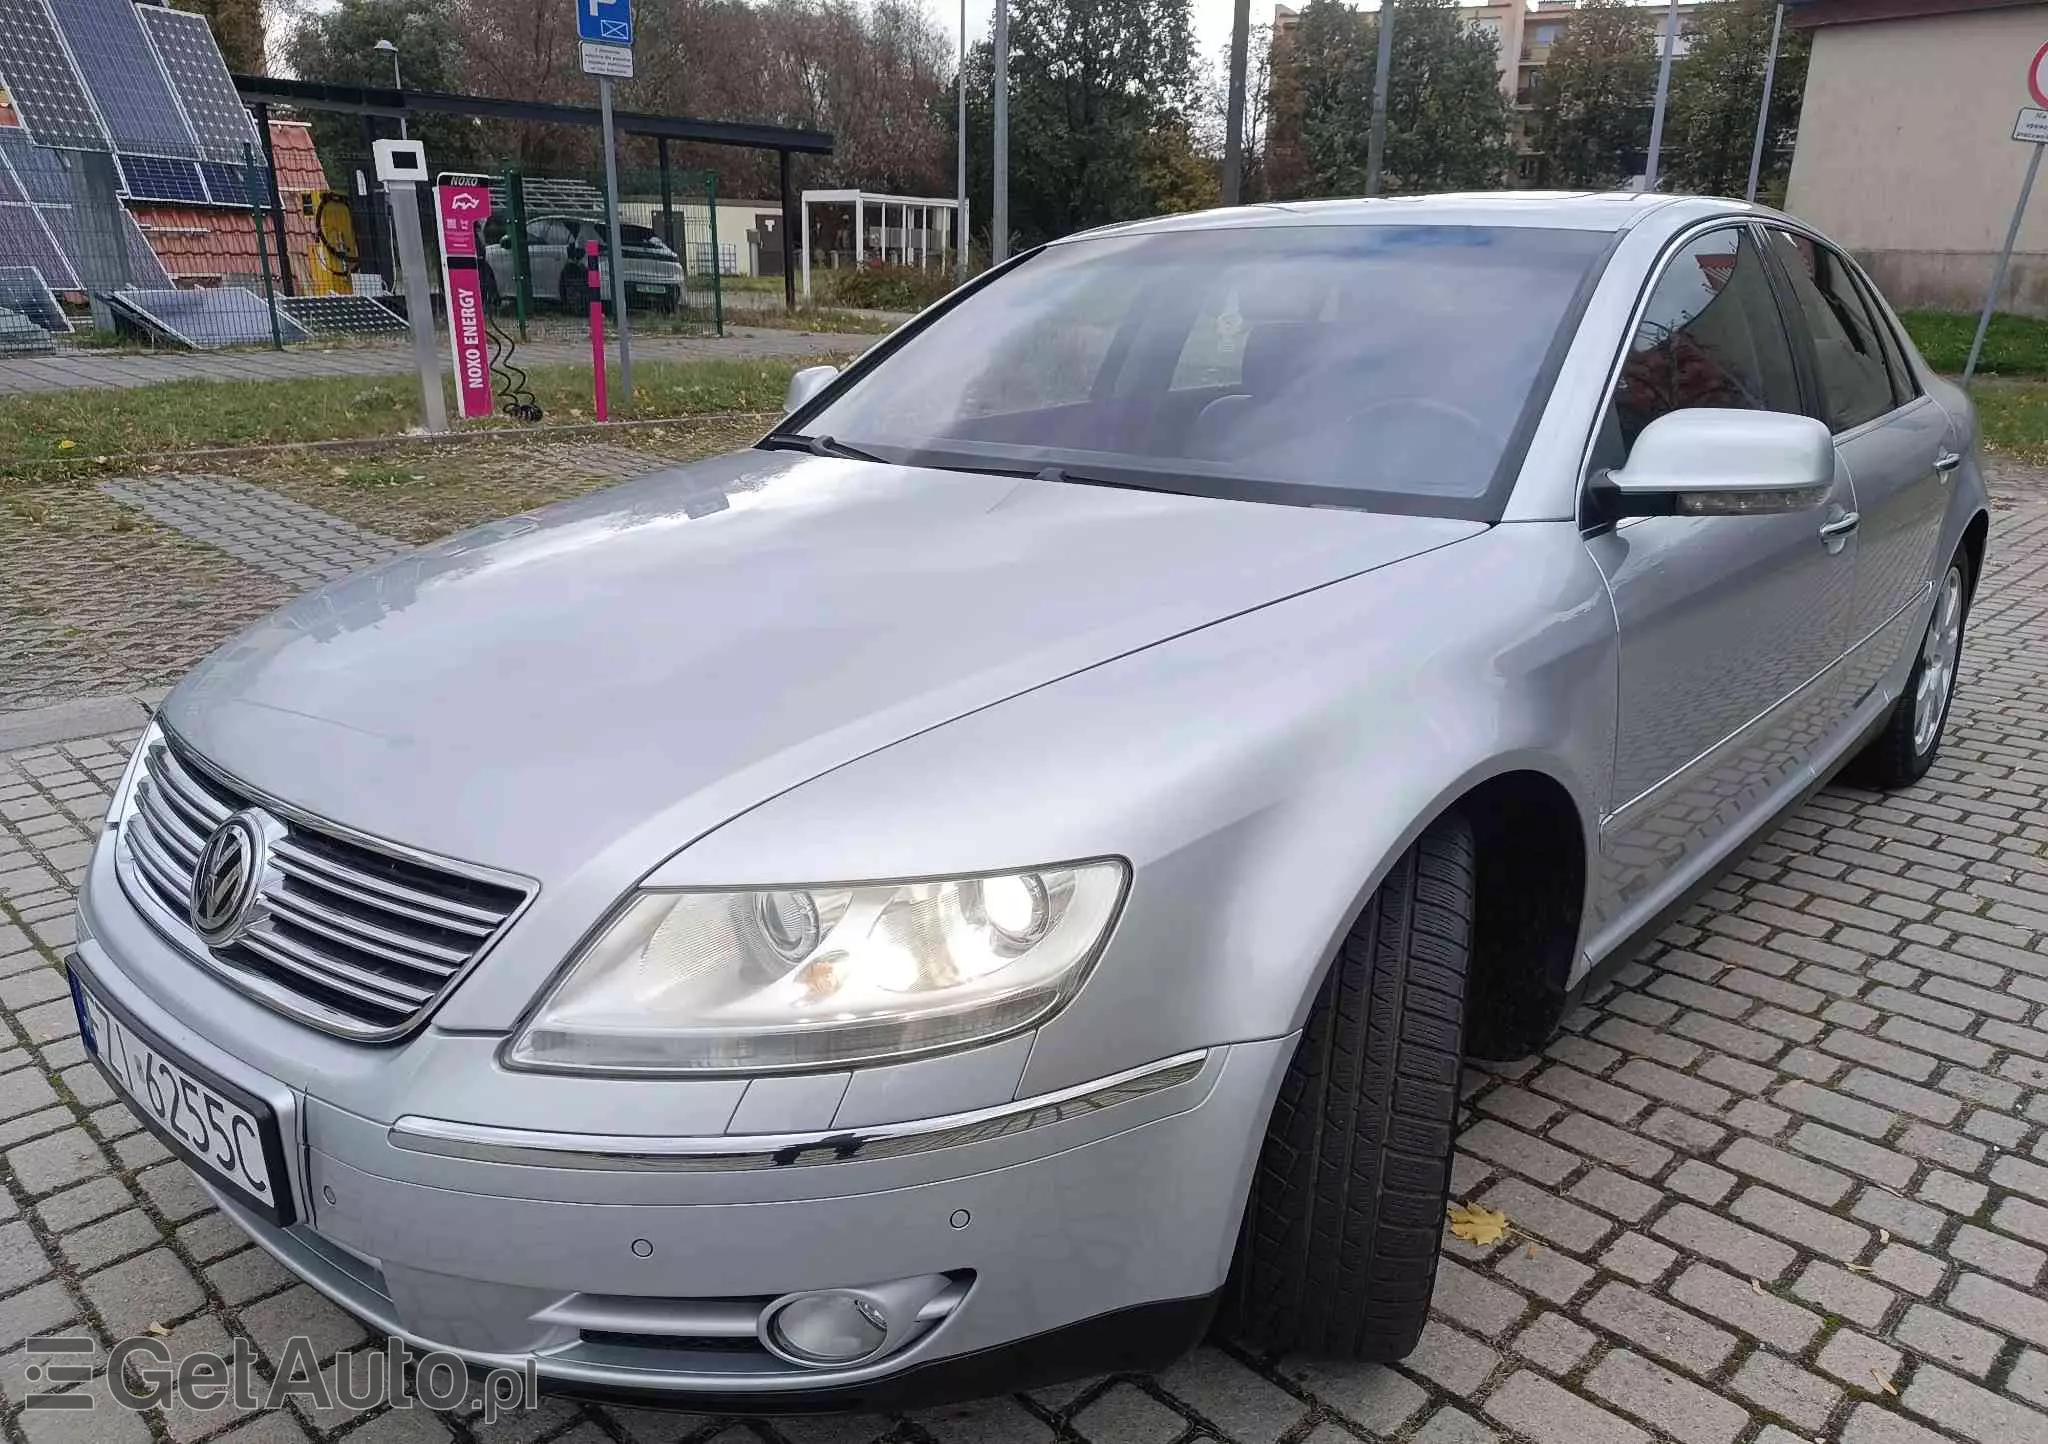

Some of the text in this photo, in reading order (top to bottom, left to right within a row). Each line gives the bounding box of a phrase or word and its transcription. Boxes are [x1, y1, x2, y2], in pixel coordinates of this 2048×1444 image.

[450, 176, 478, 186] NOXO
[458, 288, 484, 389] NOXO ENERGY
[146, 1053, 266, 1192] 6255C
